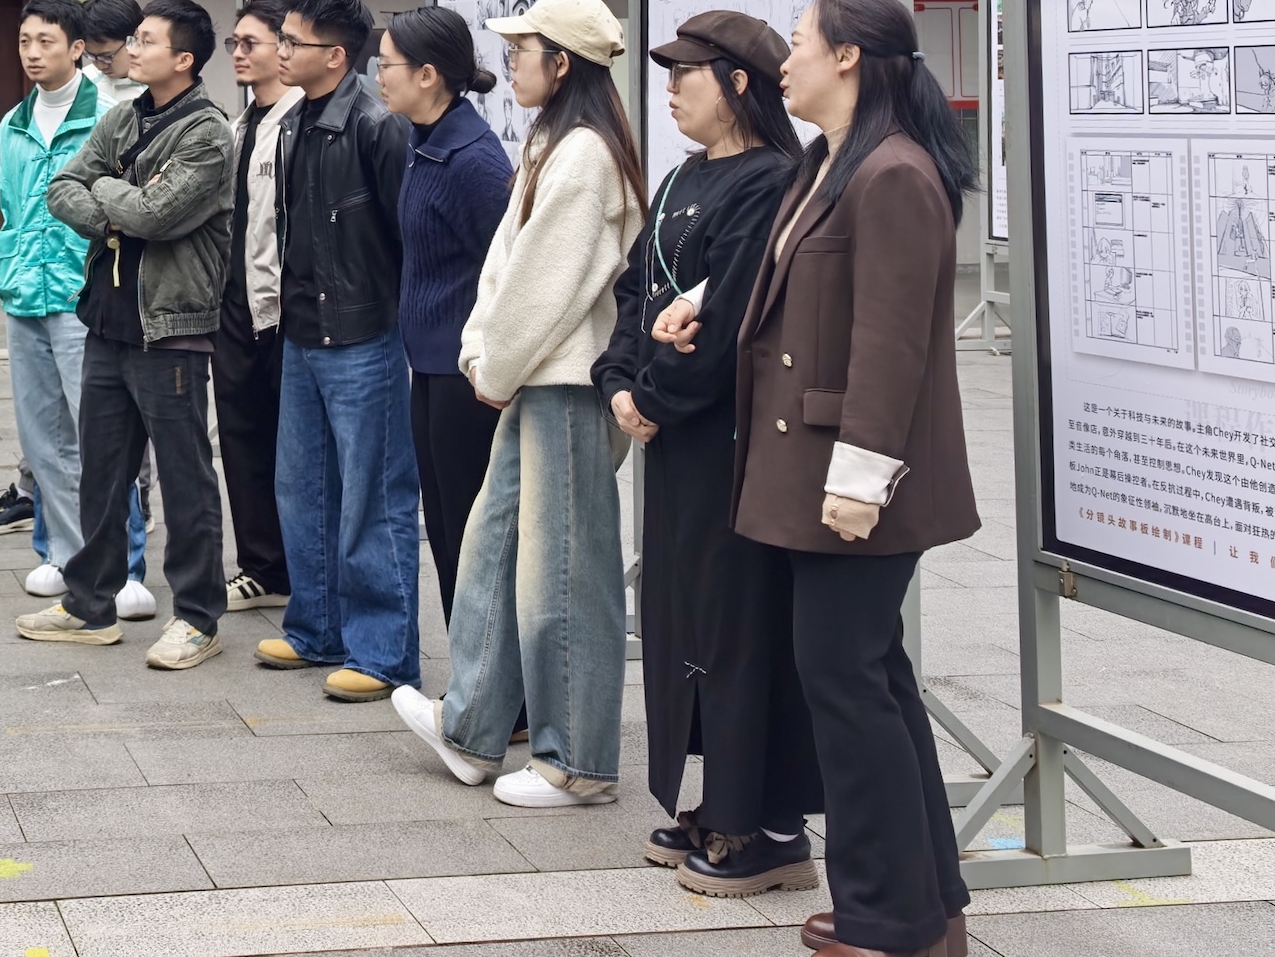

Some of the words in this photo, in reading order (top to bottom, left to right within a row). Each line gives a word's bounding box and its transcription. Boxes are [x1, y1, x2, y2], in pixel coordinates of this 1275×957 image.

[1078, 506, 1203, 549] 《分镜头故事板绘制》课程
